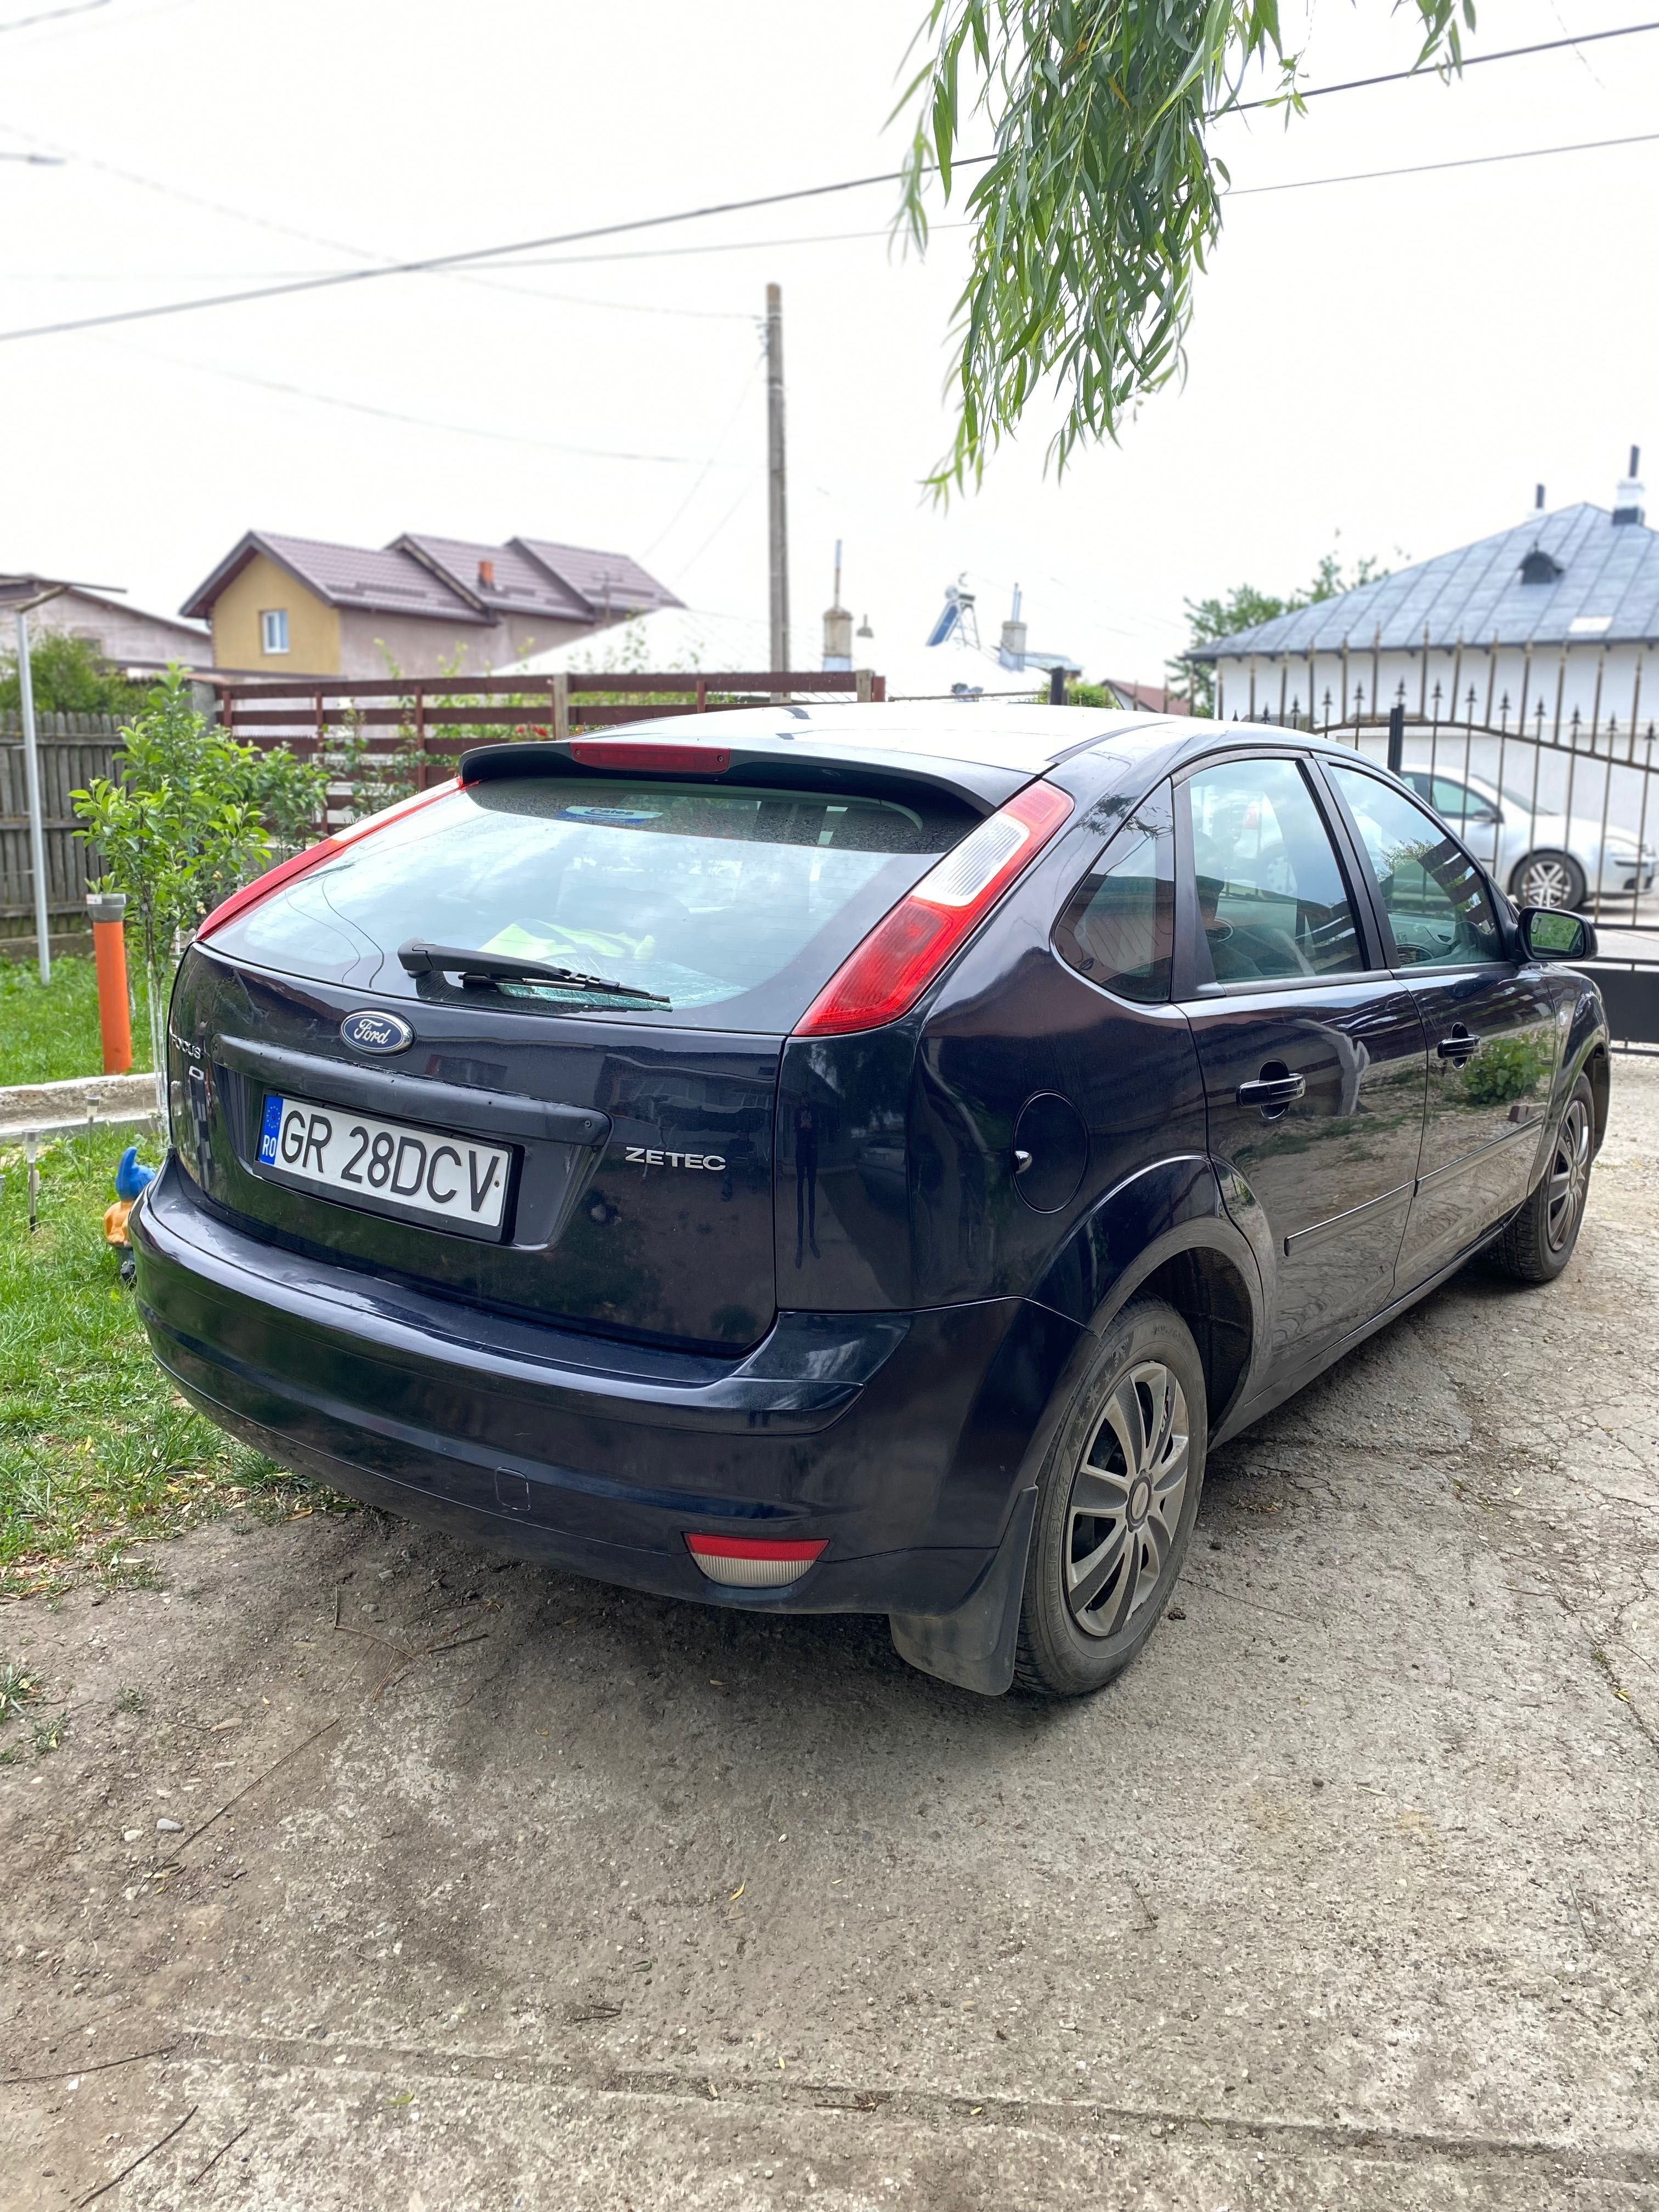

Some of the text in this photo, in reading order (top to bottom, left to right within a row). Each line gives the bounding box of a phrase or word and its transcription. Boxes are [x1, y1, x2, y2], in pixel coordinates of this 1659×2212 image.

[353, 1019, 391, 1045] Ford
[262, 1134, 277, 1158] RO
[281, 1110, 500, 1212] GR 28DCV
[625, 1147, 726, 1171] ZETEC
